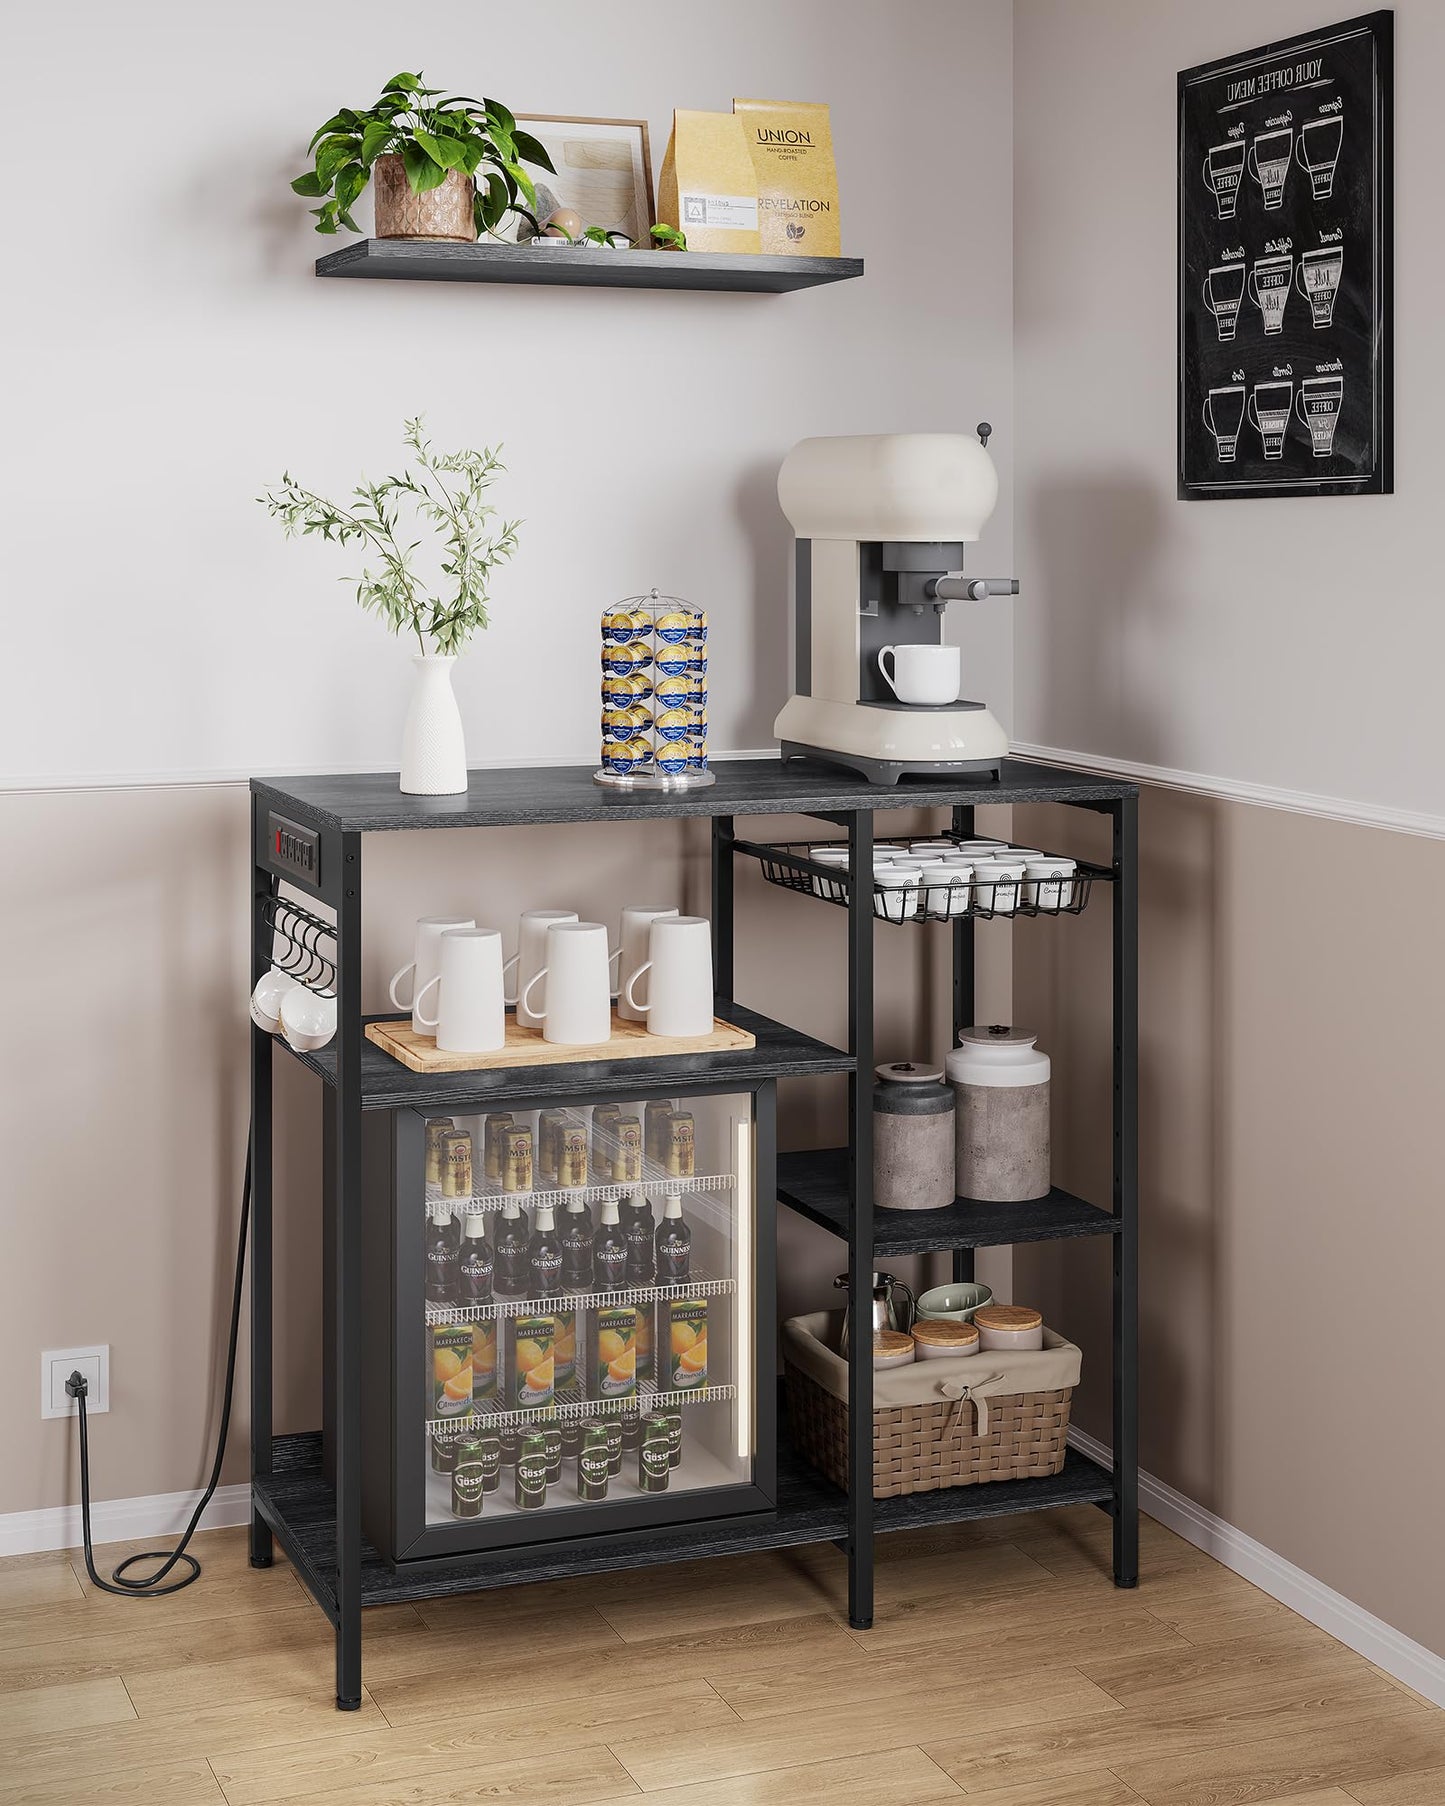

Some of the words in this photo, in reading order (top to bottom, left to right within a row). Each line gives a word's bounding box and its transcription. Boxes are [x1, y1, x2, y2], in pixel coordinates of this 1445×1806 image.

[757, 128, 811, 144] UNION
[758, 198, 830, 212] REVELATION
[672, 1310, 707, 1319] MARRAKECH
[600, 1318, 636, 1328] MARRAKECH
[518, 1327, 554, 1337] MARRAKECH
[436, 1336, 473, 1345] MARRAKECH
